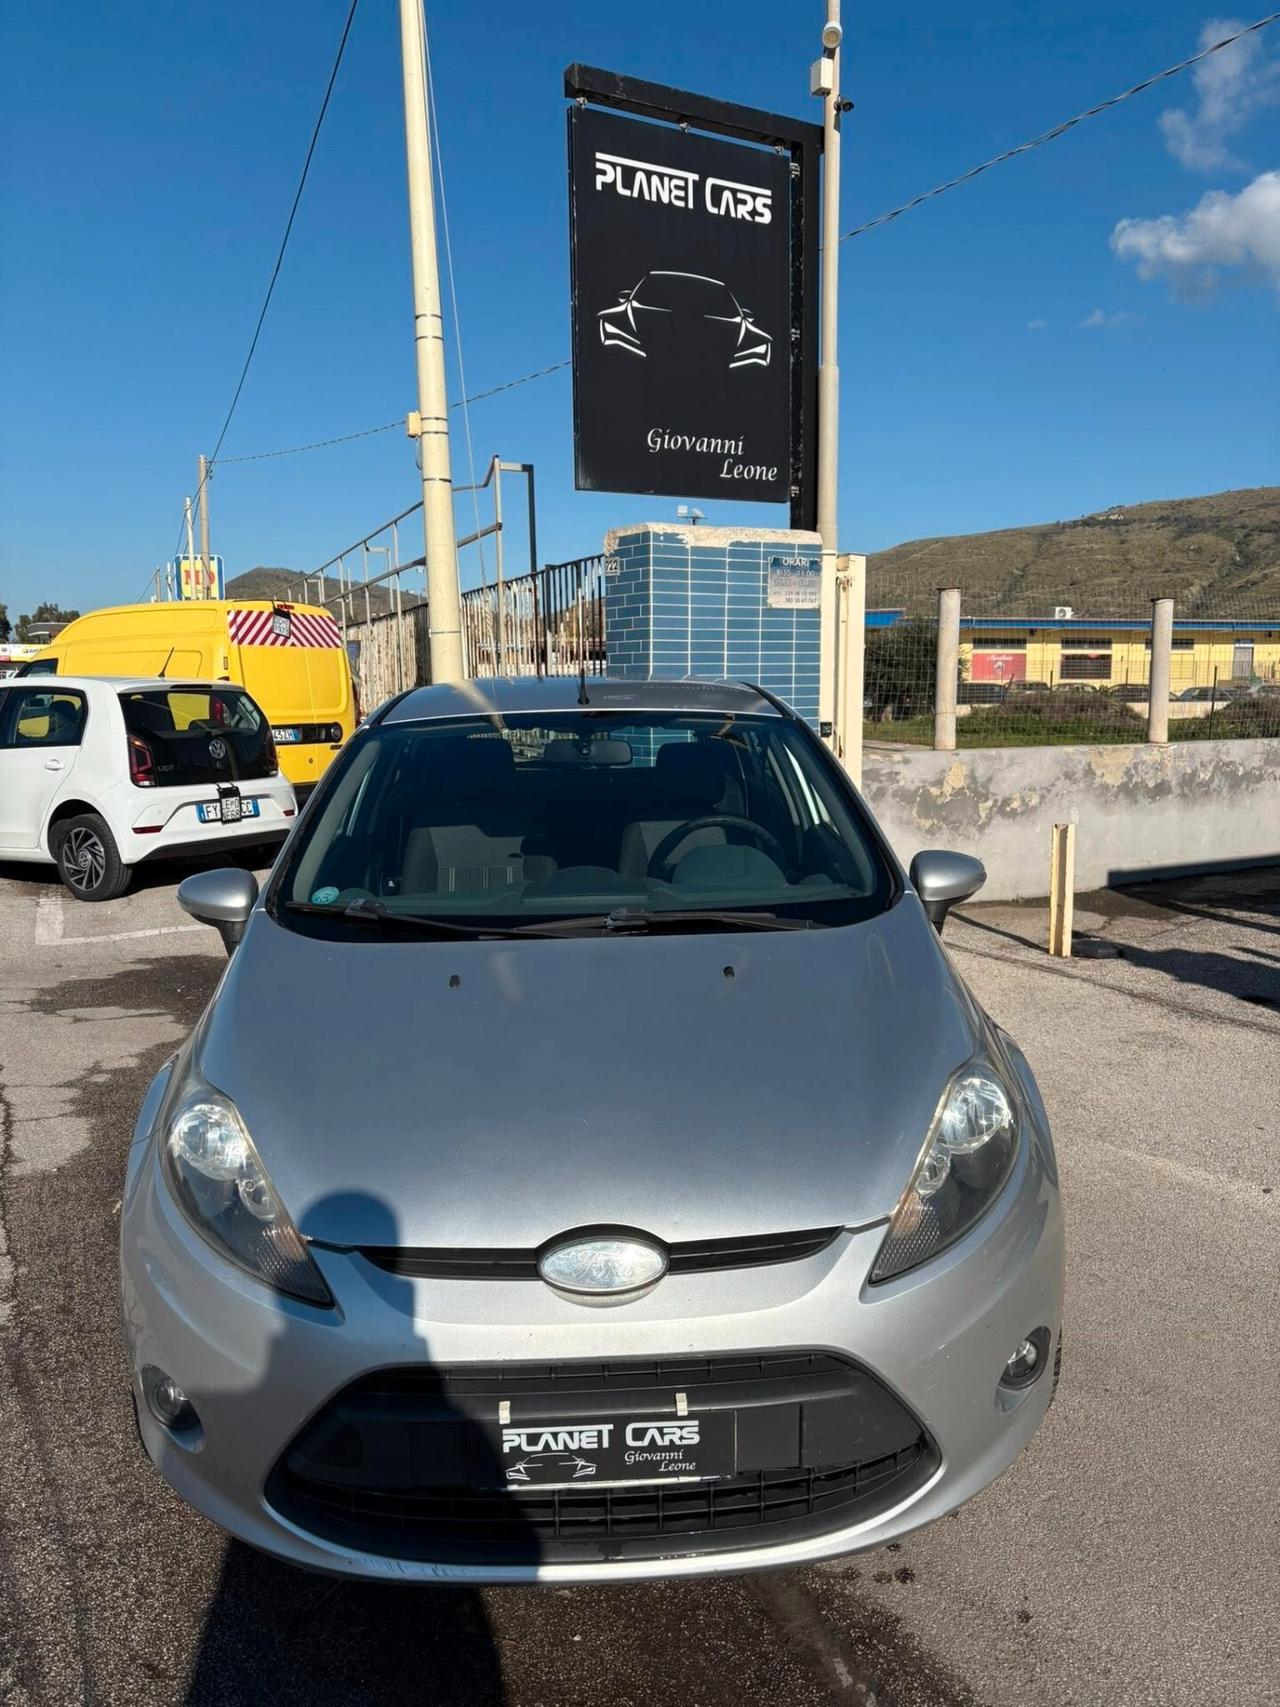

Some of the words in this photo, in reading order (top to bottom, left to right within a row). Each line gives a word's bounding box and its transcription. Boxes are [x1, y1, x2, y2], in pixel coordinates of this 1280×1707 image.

[595, 152, 699, 209] PLANET
[705, 177, 772, 224] CARS
[647, 428, 744, 455] Giovanni
[720, 459, 777, 481] Leone
[502, 1424, 614, 1453] PLANET
[625, 1420, 700, 1447] CARS
[624, 1449, 683, 1465] Giovanni
[658, 1460, 697, 1472] Leone
